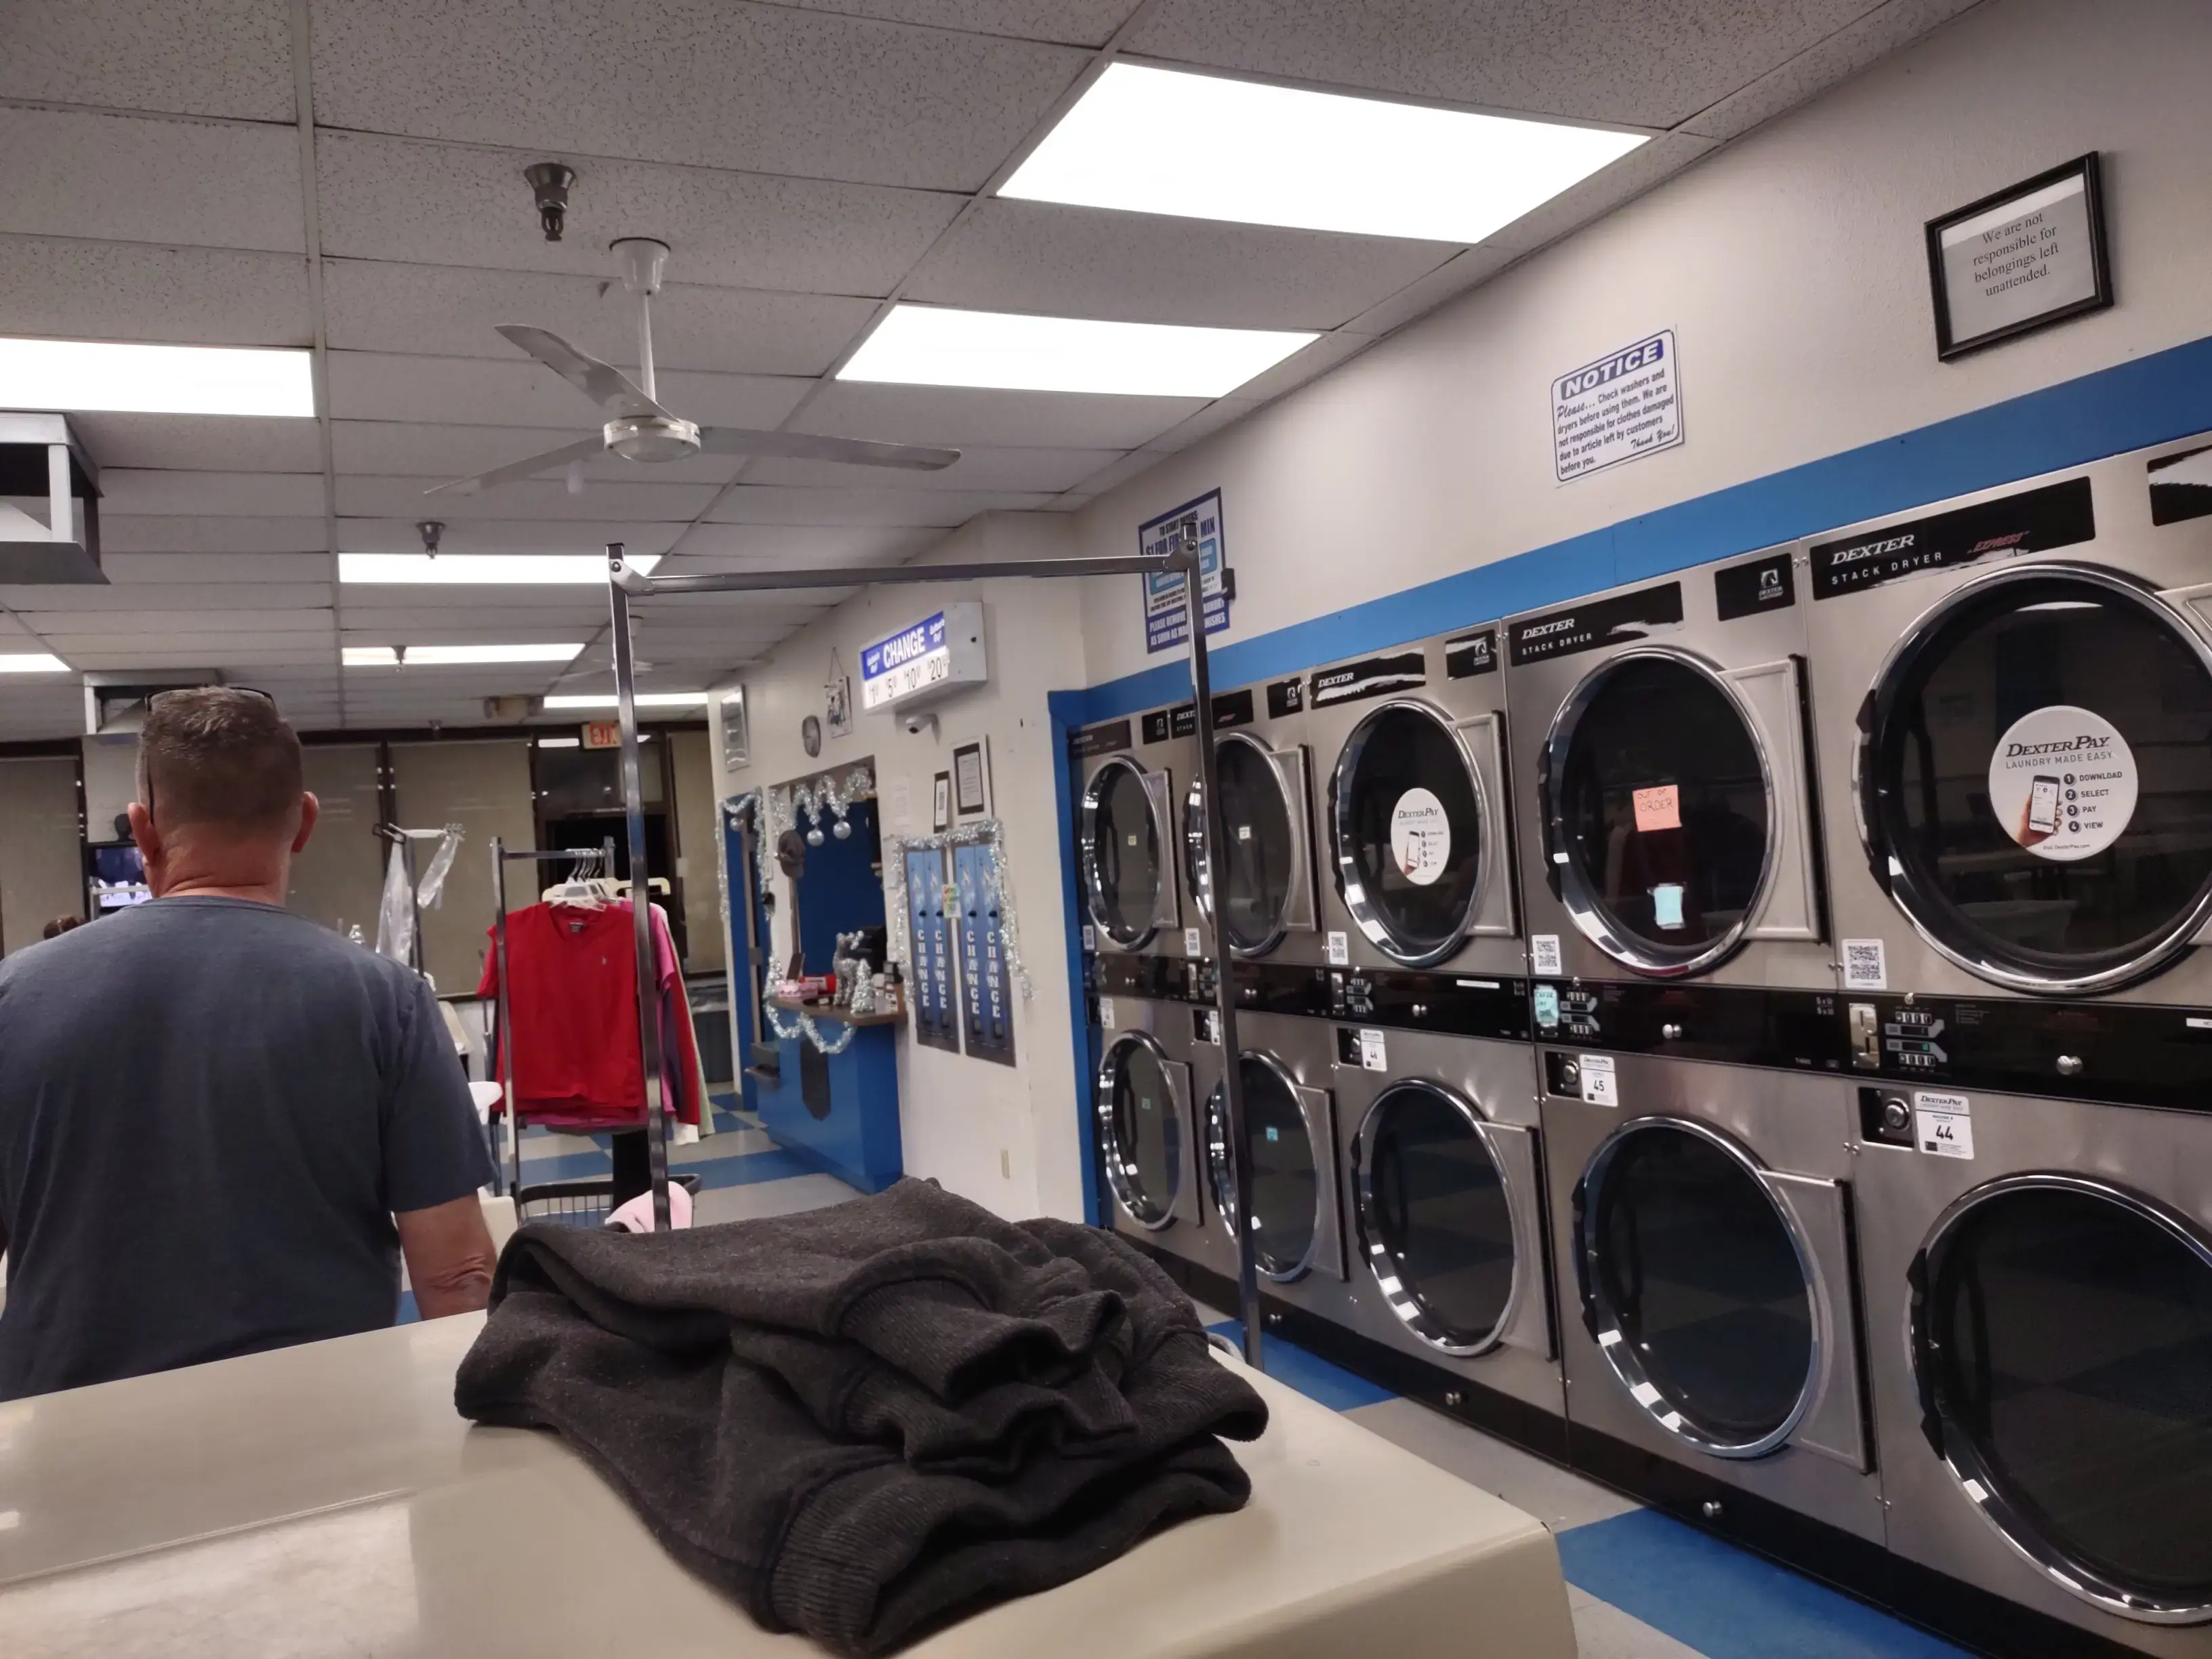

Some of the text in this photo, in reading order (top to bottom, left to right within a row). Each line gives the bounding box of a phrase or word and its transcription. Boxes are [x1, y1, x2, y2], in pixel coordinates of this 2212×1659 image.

[1982, 212, 2043, 245] We are not
[1973, 226, 2057, 266] responsible for
[1975, 242, 2059, 283] belongings left
[1986, 264, 2051, 296] unattended.
[1565, 342, 1659, 398] NOTICE
[1557, 368, 1664, 422] Please... Check washers and
[1557, 384, 1667, 435] dryers before using them. We are
[1558, 393, 1675, 448] not responsible for clothes damaged
[1559, 415, 1663, 462] due to article left by customers
[1631, 424, 1675, 449] Thank You!
[1560, 456, 1596, 475] before you.
[1830, 534, 1915, 565] DEXTER
[1831, 552, 1942, 585] STACK DRYER
[1521, 618, 1575, 640] DEXTER
[1522, 633, 1593, 655] STACK DRYER
[883, 626, 926, 668] CHANGE
[1317, 672, 1354, 688] DEXTER
[2005, 751, 2112, 769] LAUNDRY MADE EASY
[2079, 771, 2123, 782] DOWNLOAD
[1639, 798, 1674, 813] ORDER
[2081, 789, 2109, 798] SELECT
[1594, 1080, 1604, 1092] 45
[1936, 1125, 1954, 1140] 44
